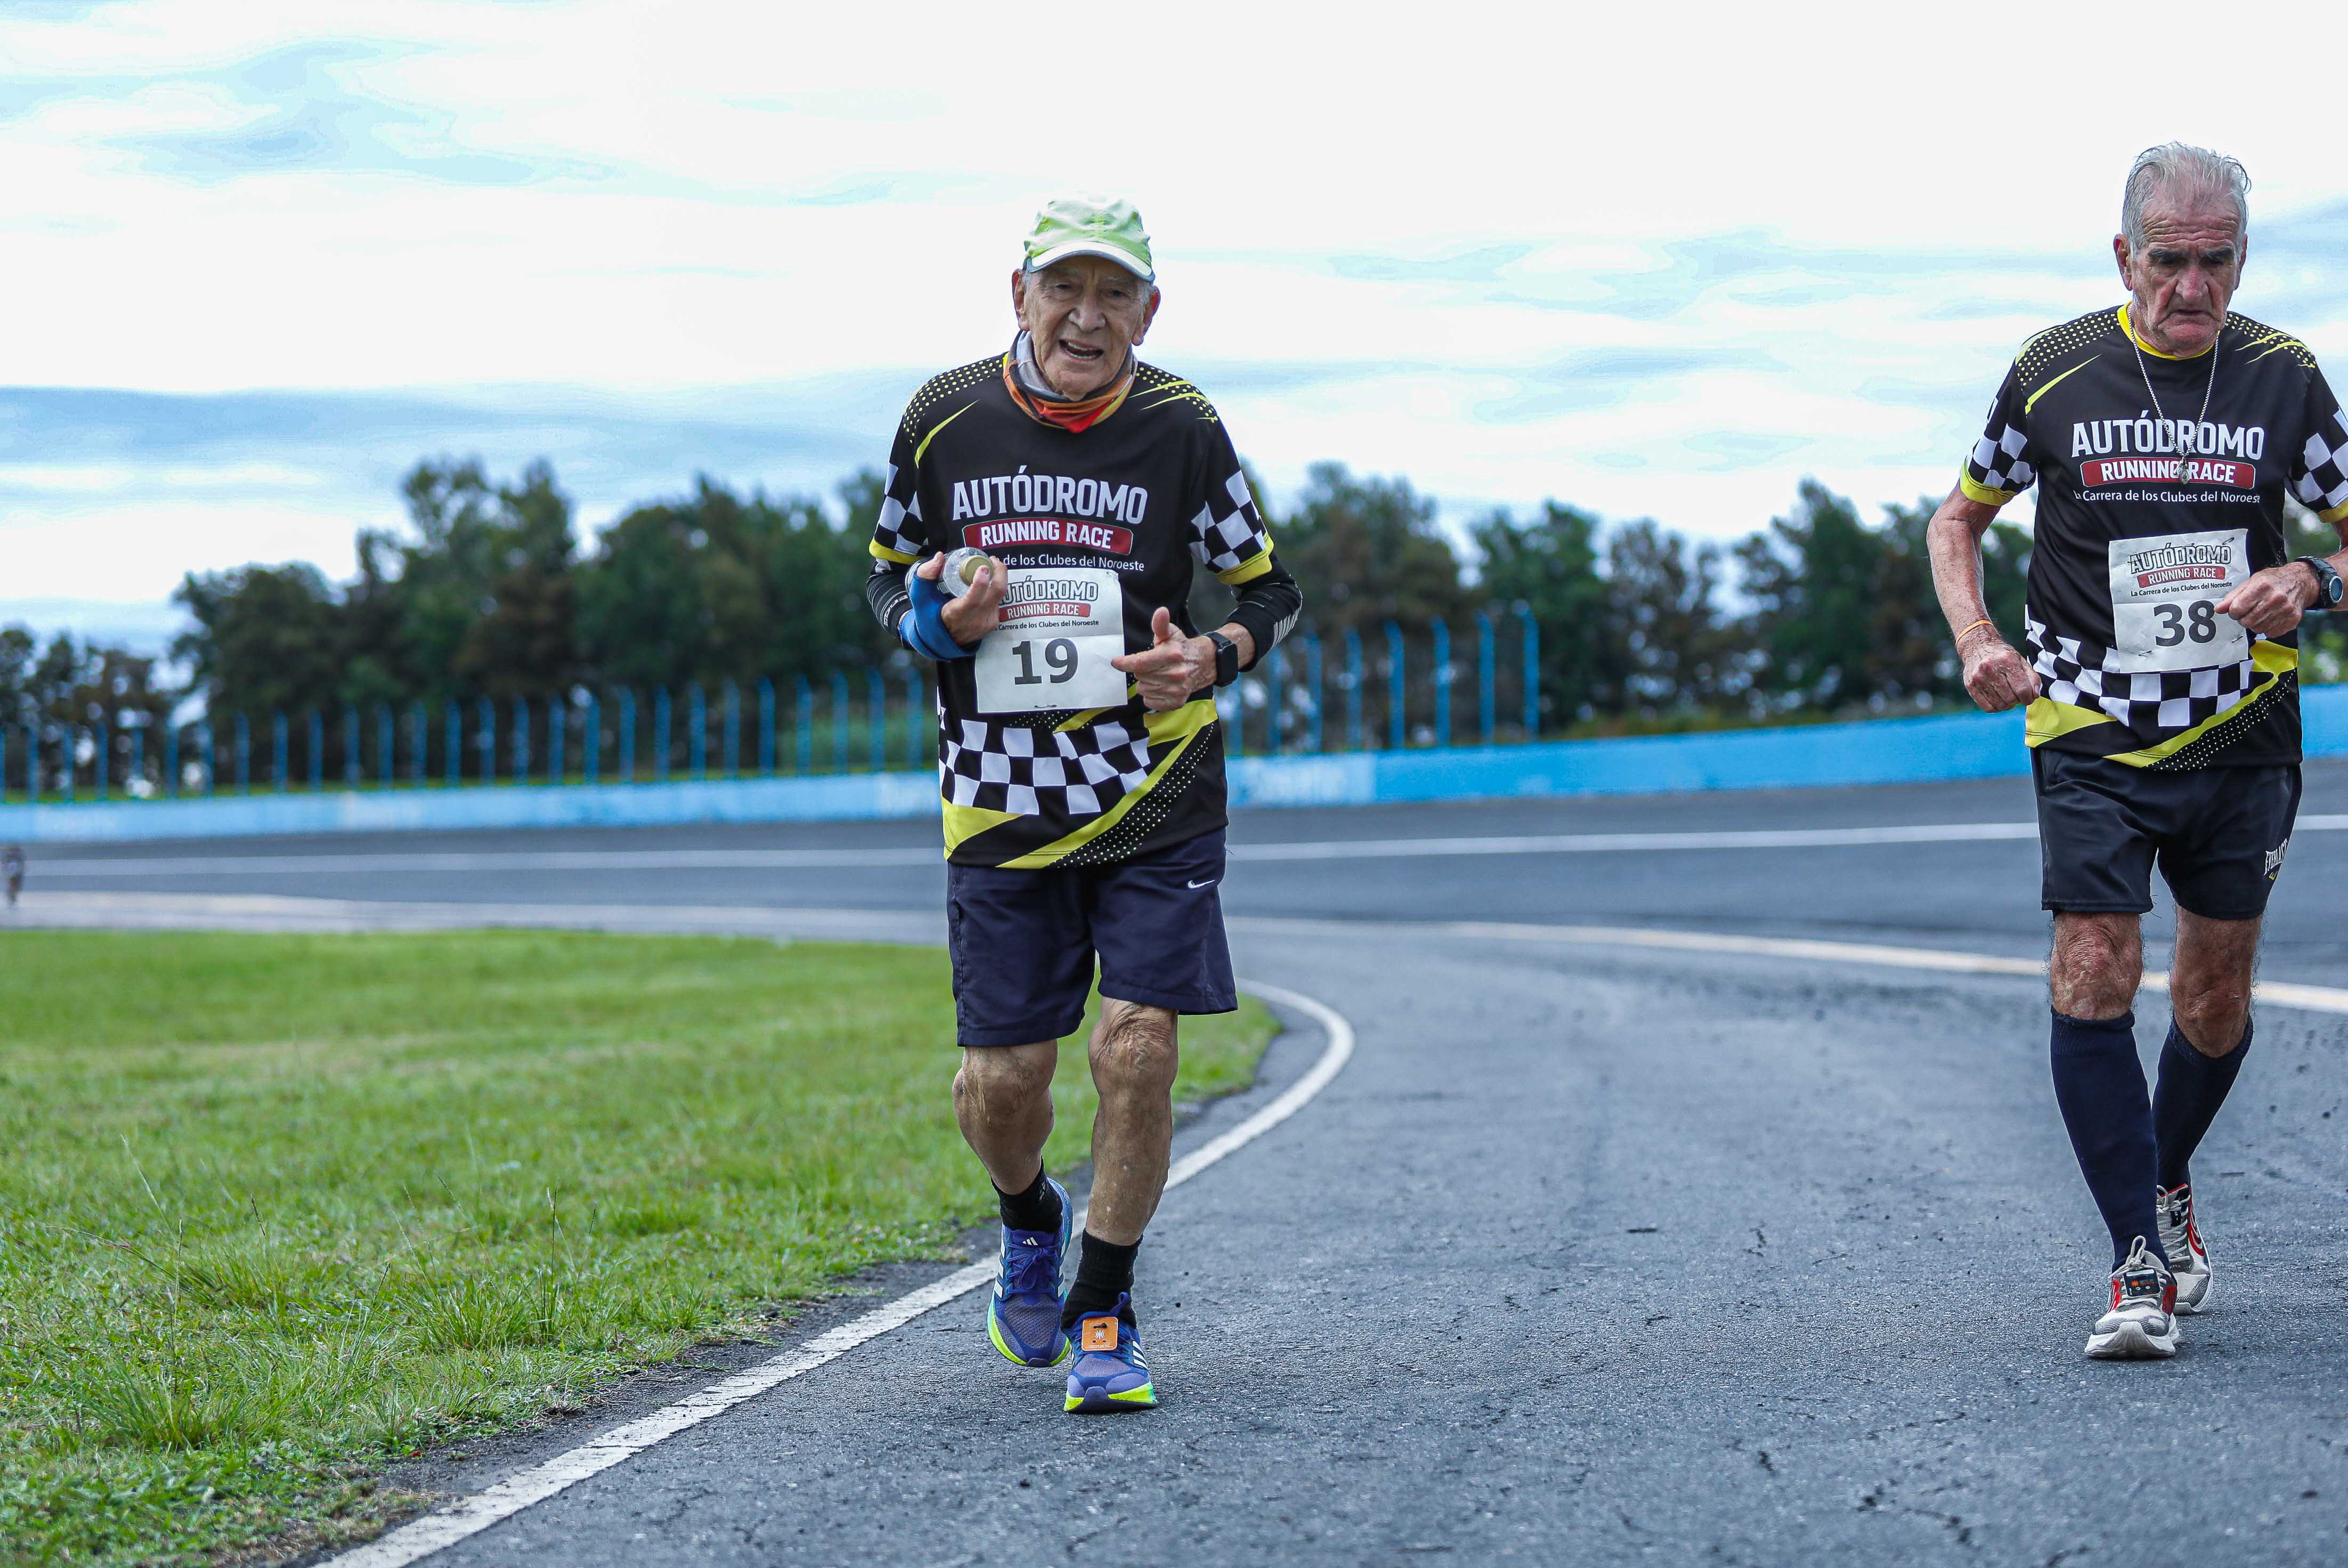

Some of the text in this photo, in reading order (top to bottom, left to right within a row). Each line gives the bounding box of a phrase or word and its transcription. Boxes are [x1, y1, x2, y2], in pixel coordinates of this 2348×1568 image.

[2071, 410, 2264, 460] AUTÓDROMO
[2100, 460, 2236, 483] RUNNING RACE
[953, 465, 1148, 525] AUTÓDROMO
[2083, 490, 2122, 501] Carrera
[2125, 490, 2139, 500] de
[2142, 490, 2158, 501] los
[2160, 491, 2197, 502] Clubes
[2200, 491, 2217, 502] del
[981, 520, 1114, 549] RUNNING RACE
[1003, 554, 1144, 571] de los Clubes del Noroeste
[2130, 542, 2231, 574] AUTÓDROMO
[998, 575, 1099, 606] UTÓDROMO
[2148, 567, 2216, 584] RUNNING RACE
[1007, 603, 1079, 619] RUNNING RACE
[2153, 600, 2216, 647] 38
[1012, 638, 1078, 685] 19
